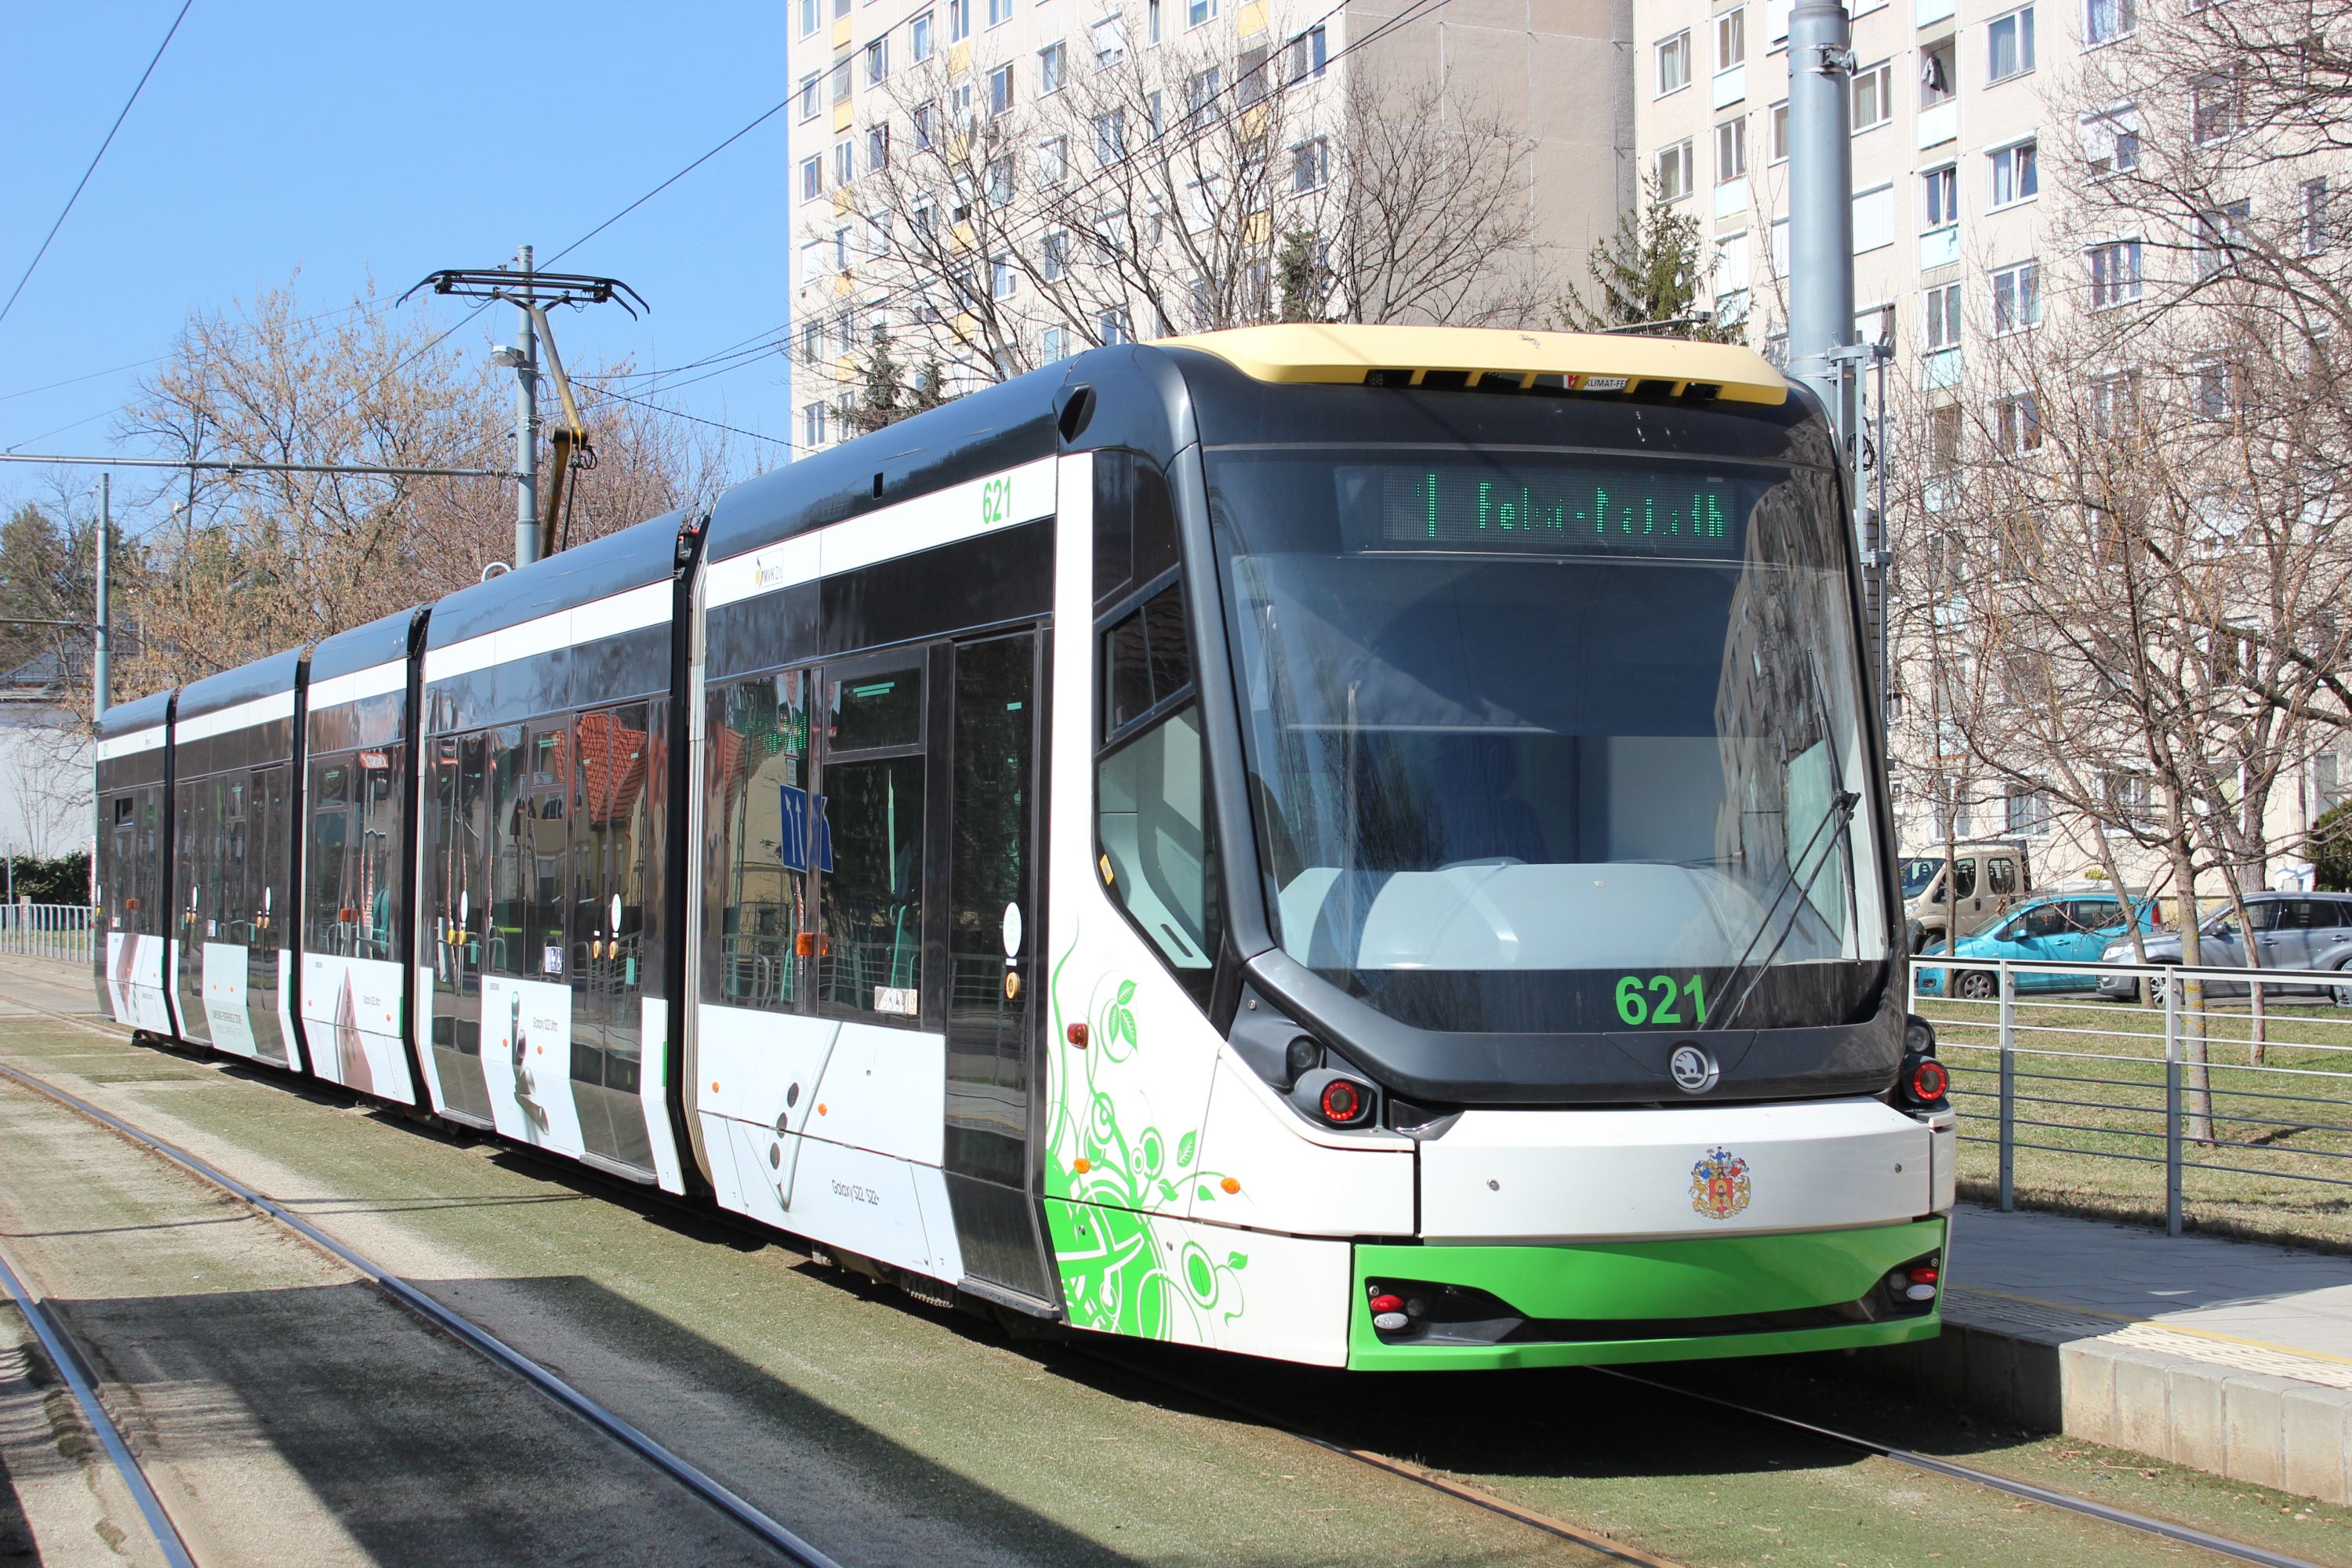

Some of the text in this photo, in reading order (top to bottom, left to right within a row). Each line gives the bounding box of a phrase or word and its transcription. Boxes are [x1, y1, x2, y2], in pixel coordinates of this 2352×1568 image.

[982, 475, 1011, 524] 621
[1615, 975, 1708, 1025] 621
[832, 1179, 853, 1203] Galaxy
[853, 1185, 865, 1202] S22
